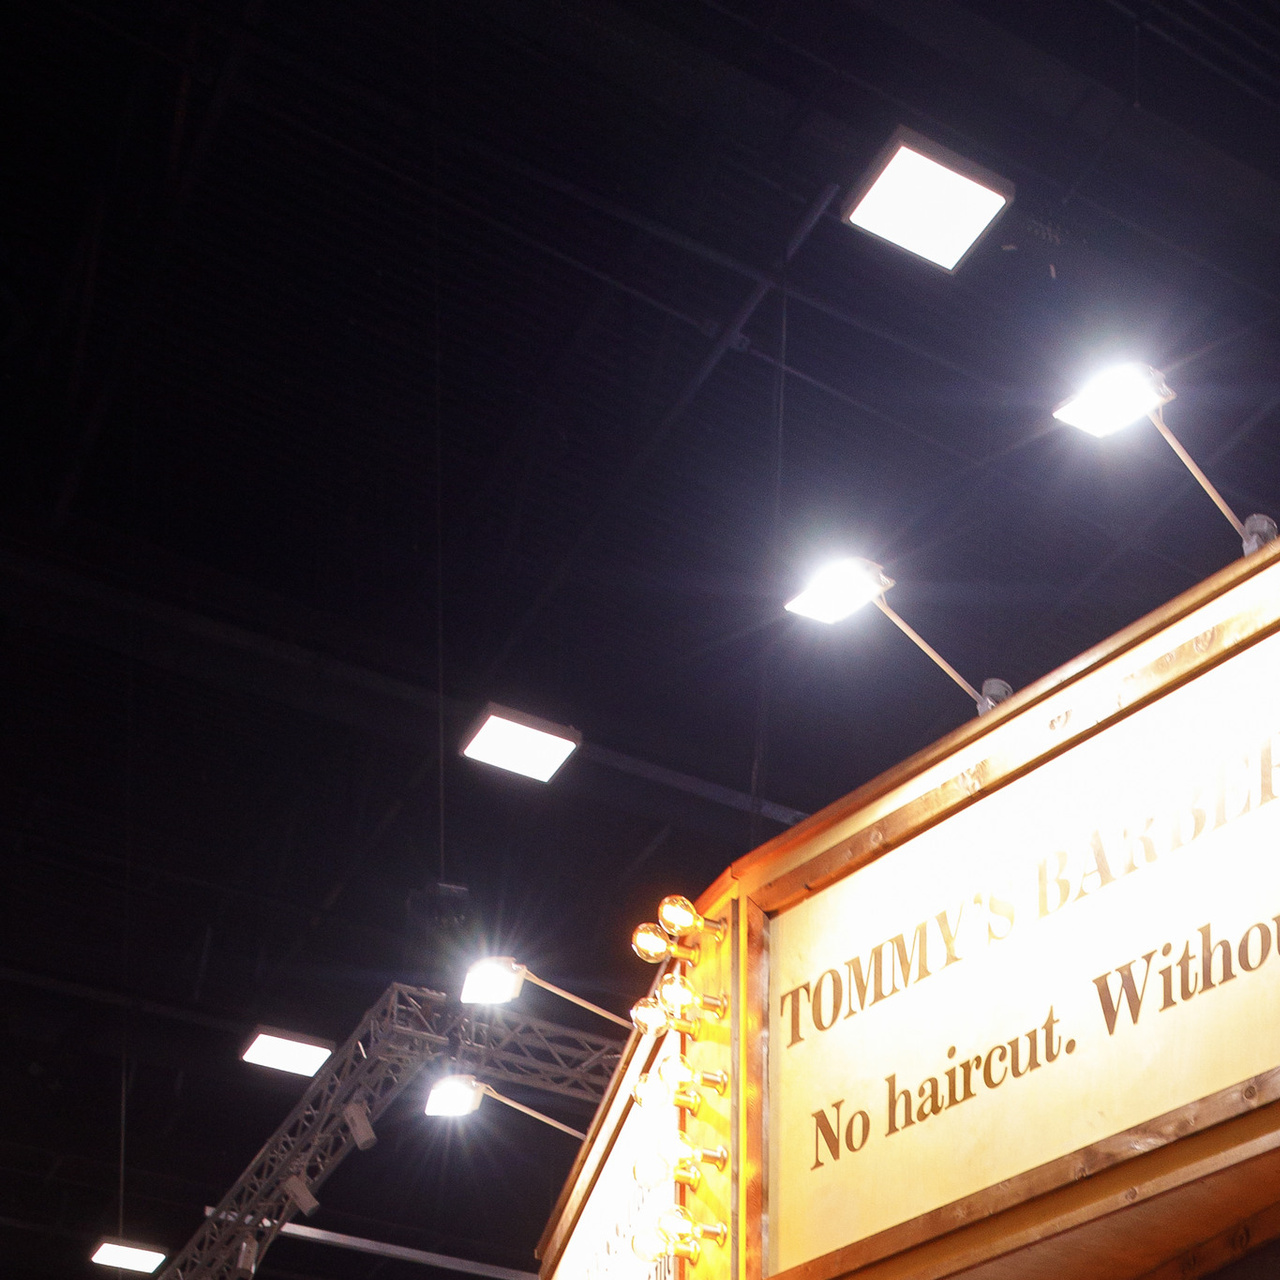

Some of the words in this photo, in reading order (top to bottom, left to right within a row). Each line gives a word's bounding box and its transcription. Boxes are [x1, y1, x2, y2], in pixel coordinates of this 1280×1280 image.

[779, 888, 1015, 1049] TOMMY'S
[810, 1099, 870, 1171] No
[884, 1004, 1077, 1137] haircut.
